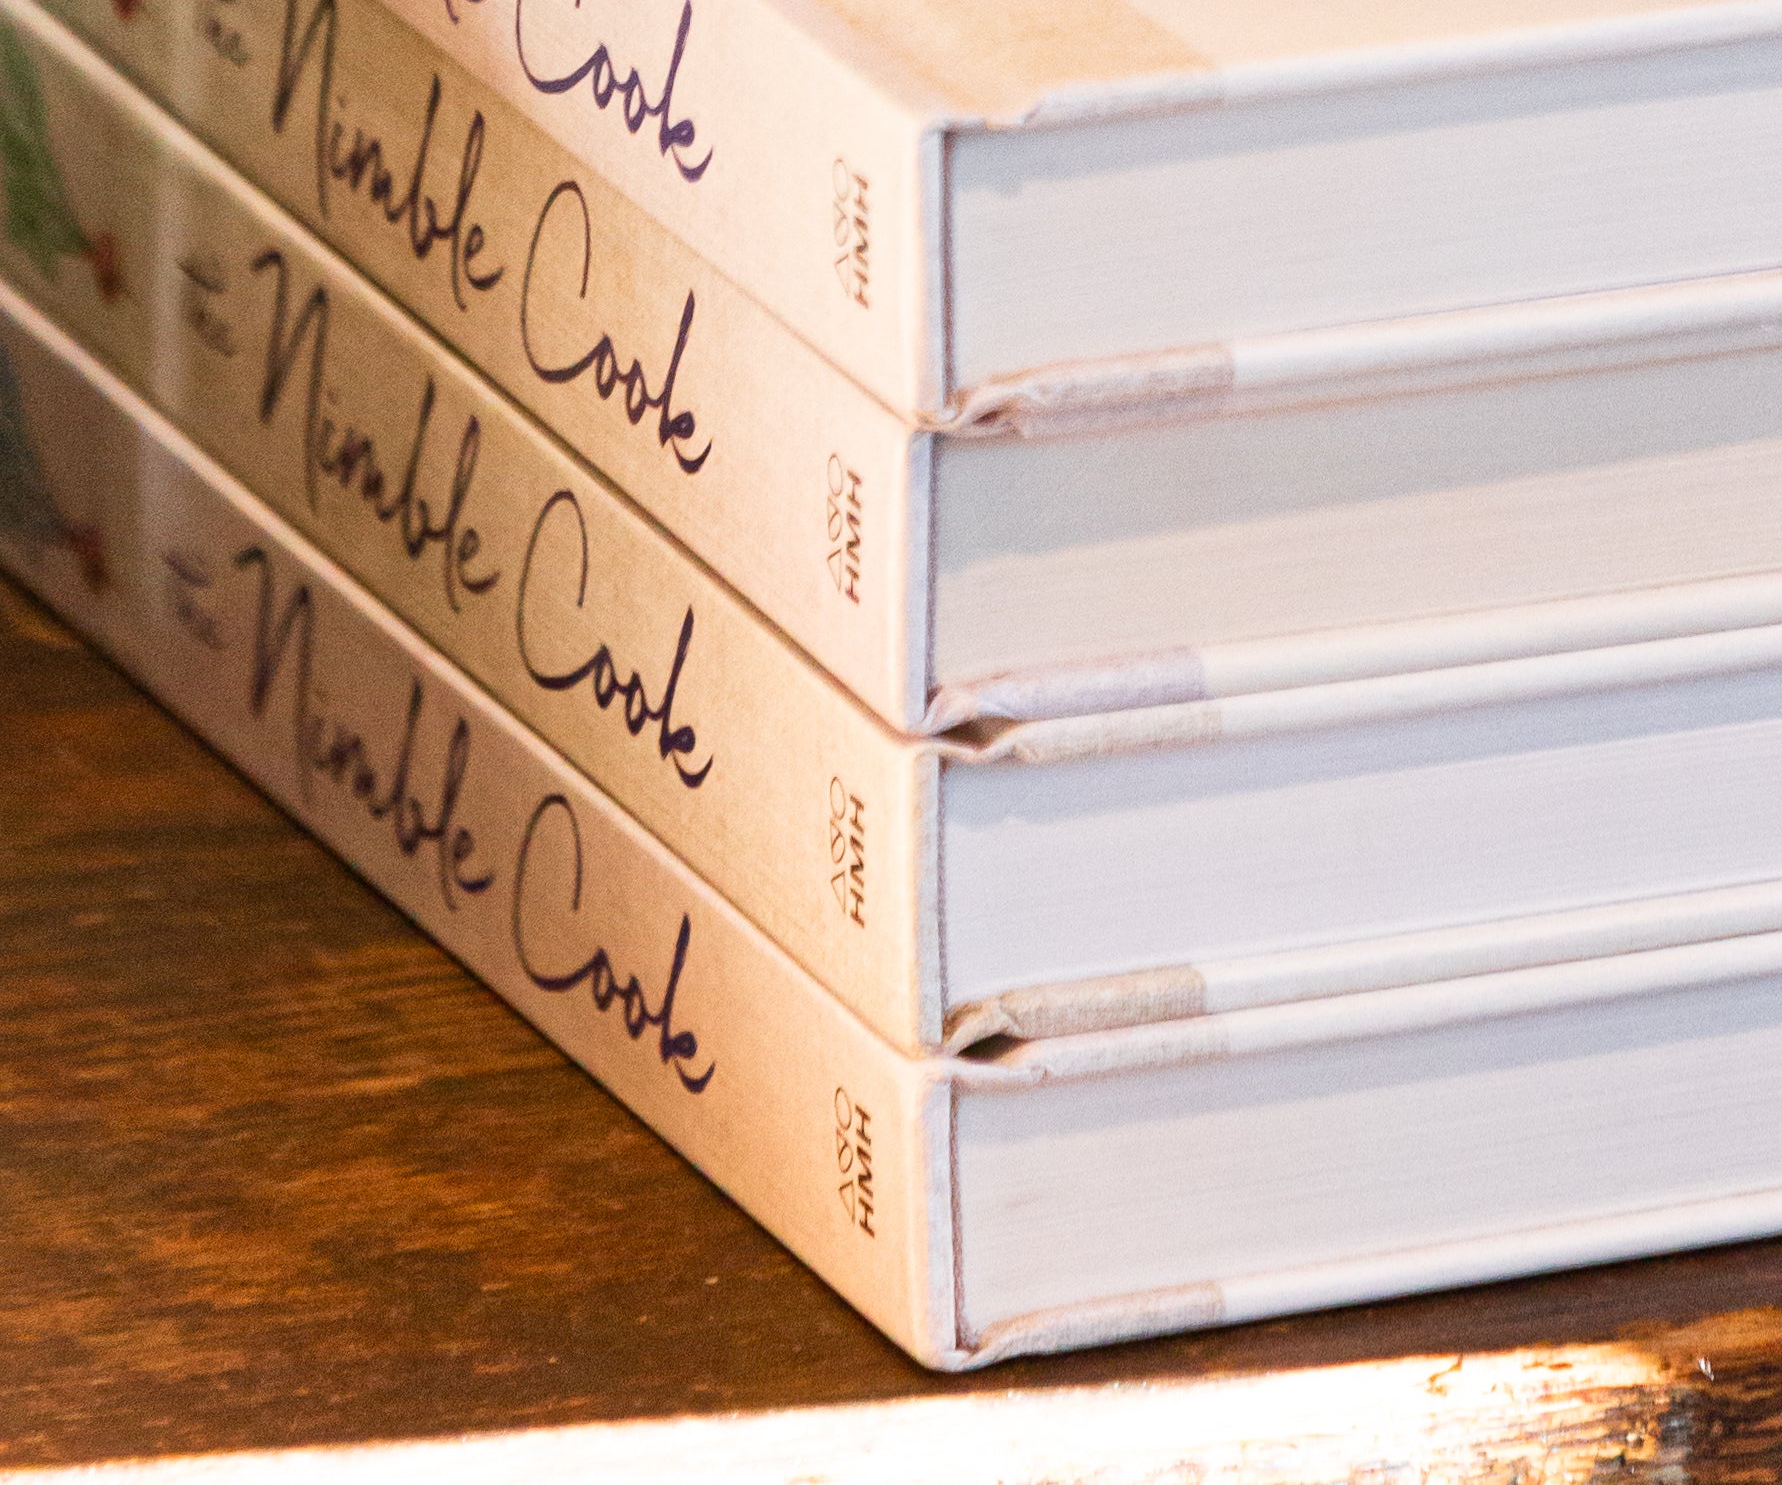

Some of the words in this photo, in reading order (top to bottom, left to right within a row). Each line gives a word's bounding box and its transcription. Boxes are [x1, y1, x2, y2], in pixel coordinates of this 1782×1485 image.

[852, 173, 869, 310] HMH
[520, 180, 712, 473] Cook
[251, 250, 500, 613] Nimble
[518, 490, 713, 789] Cook
[845, 469, 863, 606] HMH
[233, 545, 492, 911] Nimble
[512, 793, 716, 1094] Cook
[849, 794, 865, 929] HMH
[855, 1103, 875, 1238] HMH
